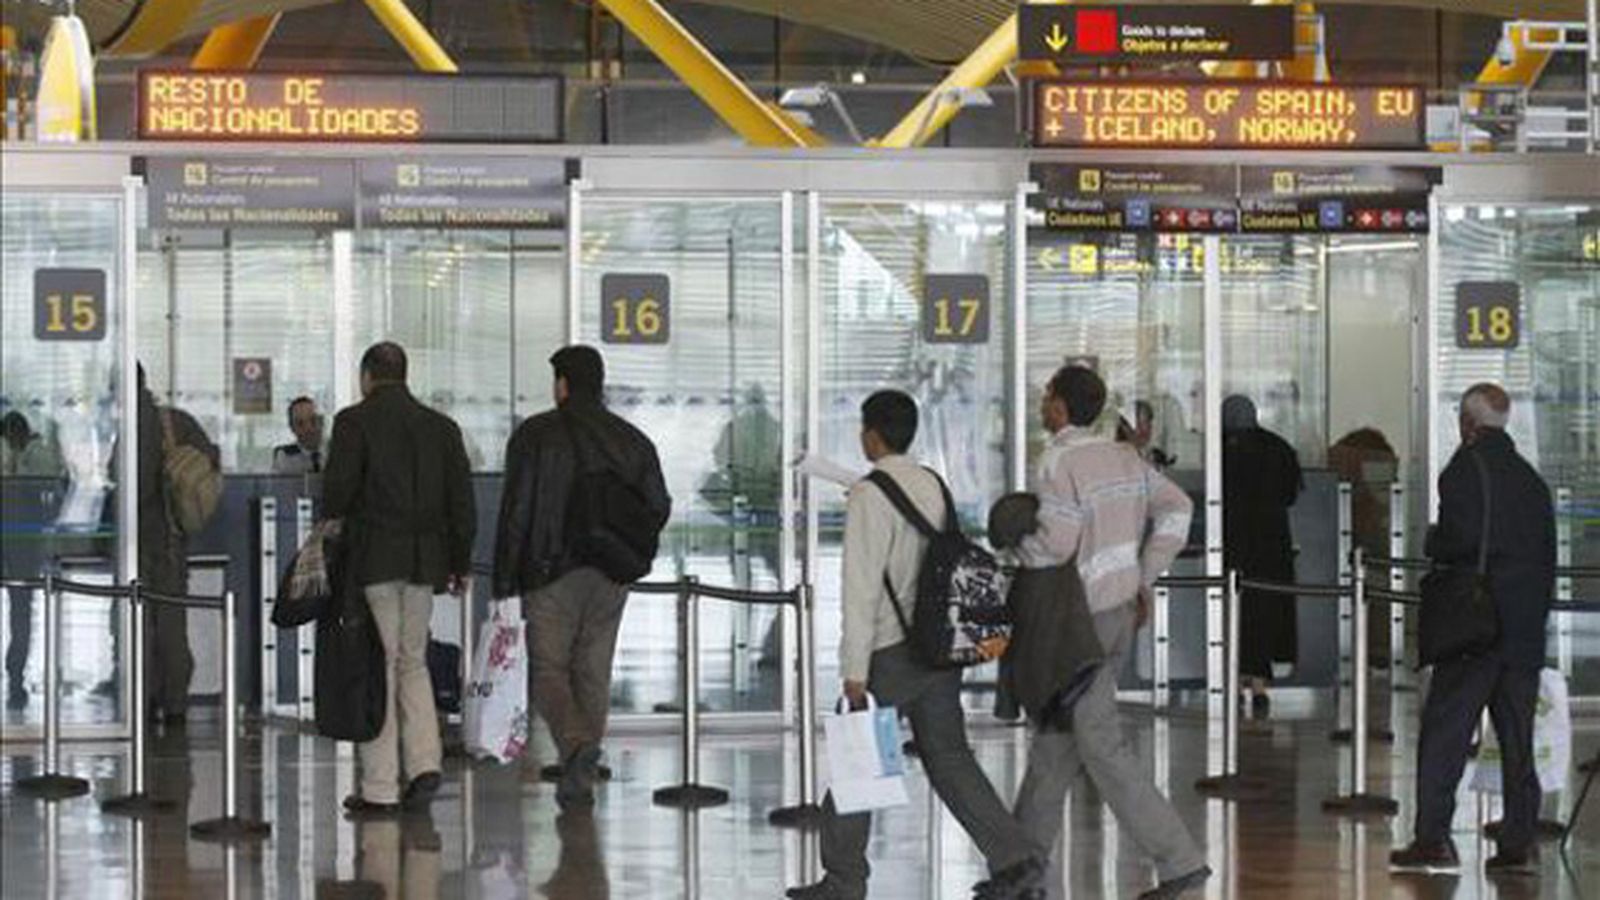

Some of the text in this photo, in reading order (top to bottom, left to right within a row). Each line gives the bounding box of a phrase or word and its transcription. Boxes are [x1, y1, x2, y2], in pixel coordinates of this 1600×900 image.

[149, 76, 324, 105] RESTO DE
[1044, 87, 1414, 116] CITIZENS OF SPAIN, EU
[149, 106, 421, 135] NACIONALIDADES
[1083, 115, 1217, 142] ICELAND,
[1238, 117, 1357, 143] NORWAY,
[46, 295, 96, 331] 15
[612, 299, 660, 335] 16
[934, 300, 979, 335] 17
[1466, 306, 1511, 341] 18
